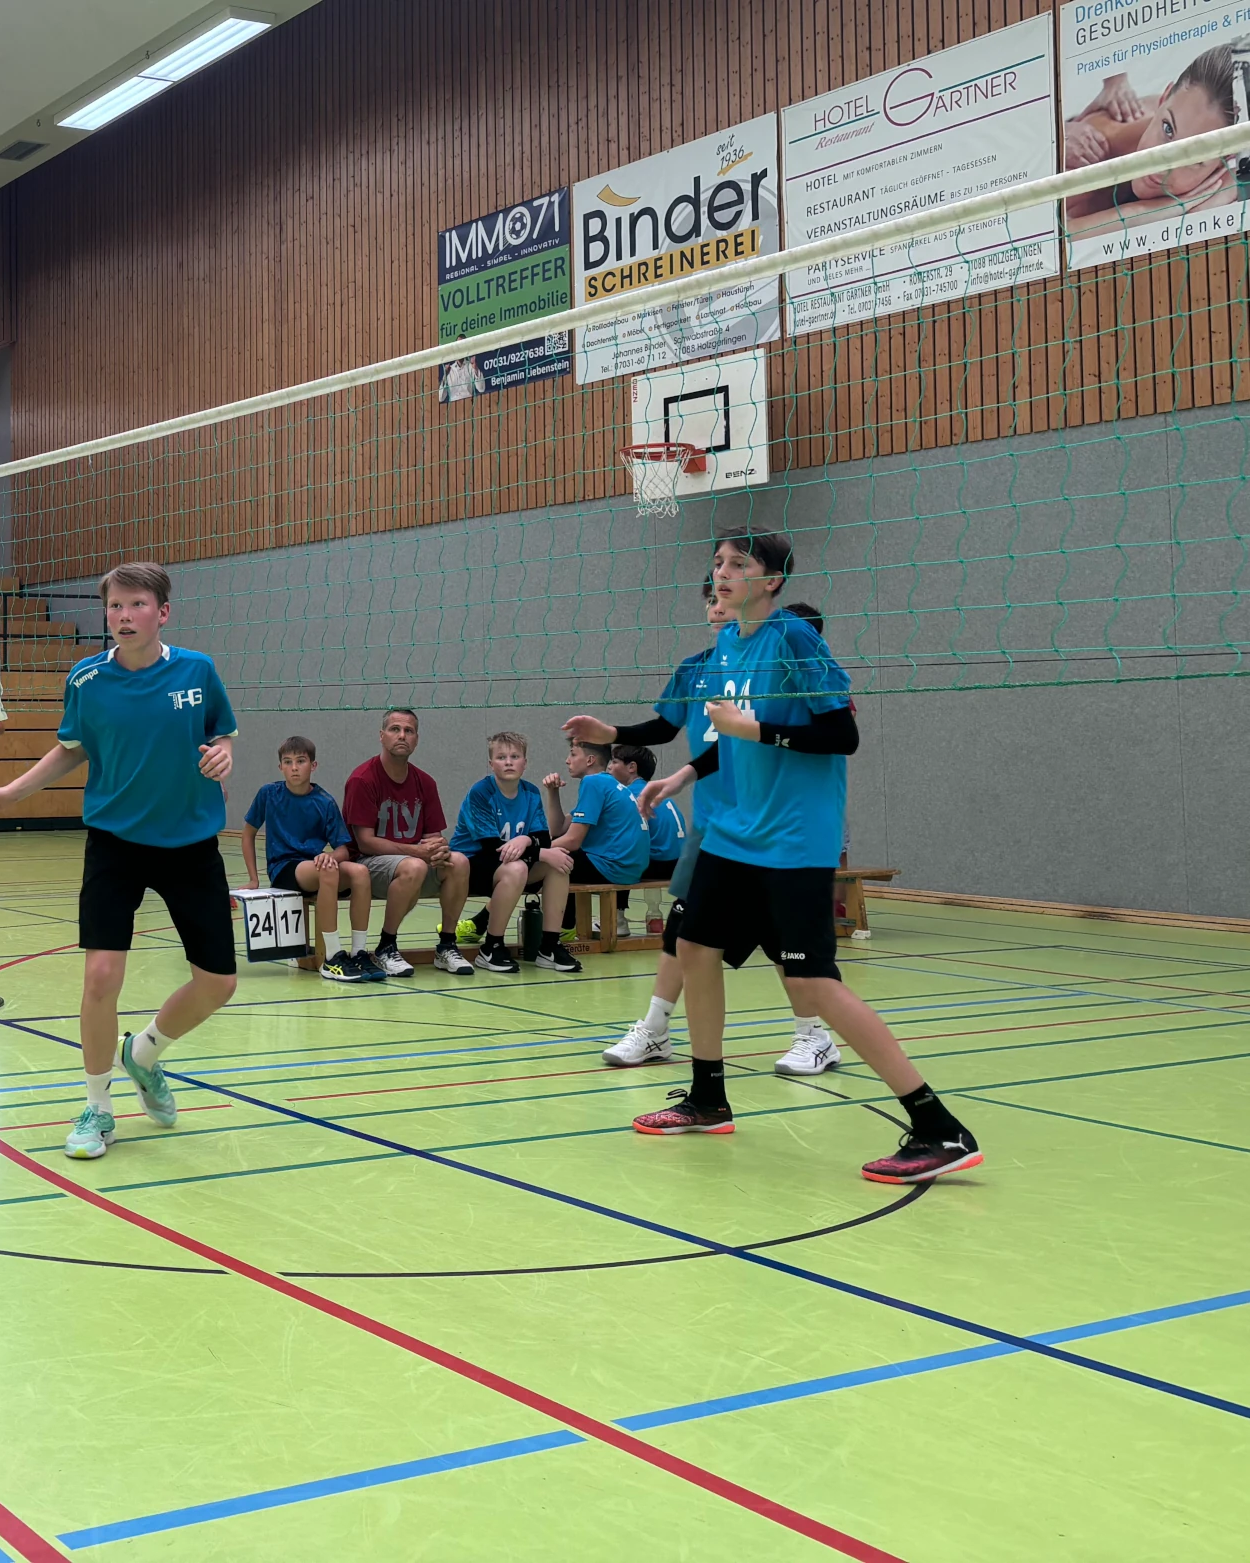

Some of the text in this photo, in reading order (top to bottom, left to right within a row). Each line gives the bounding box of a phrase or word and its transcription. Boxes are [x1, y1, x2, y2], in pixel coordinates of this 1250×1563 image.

[1077, 55, 1110, 75] Praxis
[1113, 48, 1129, 63] für
[1131, 19, 1218, 58] Physiotherapie
[1222, 14, 1232, 28] &
[814, 67, 1017, 132] HOTEL GÄRTNER
[716, 133, 735, 156] seit
[815, 121, 876, 151] Restaurant
[720, 146, 745, 169] 1936
[805, 143, 943, 192] HOTEL MIT KOMFORTABLEN ZIMMERN
[806, 187, 876, 217] RESTAURANT
[880, 181, 908, 195] TÄGLICH
[910, 170, 944, 187] GEÖFFNET
[952, 154, 997, 174] TAGESESSEN
[583, 167, 768, 271] Binder
[806, 171, 1028, 240] VERANSTALTUNGSRÄUME BIS ZU 150 PERSONEN
[445, 193, 560, 268] IMMO71
[933, 231, 947, 242] AUS
[949, 227, 966, 237] DEM
[967, 216, 1007, 233] STEINOFEN
[1103, 213, 1245, 255] www.drenke
[446, 264, 479, 280] REGIONAL
[486, 254, 512, 267] SIMPEL
[520, 238, 560, 256] INNOVATIV
[587, 229, 758, 299] SCHREINEREI
[807, 275, 821, 286] UND
[845, 265, 864, 276] MEHR
[944, 266, 953, 278] 29
[967, 256, 986, 271] 1088
[441, 257, 566, 312] VOLLTREFFER
[847, 304, 857, 315] Tel.
[903, 290, 913, 302] Fax
[914, 279, 958, 300] 0731-745700
[440, 290, 568, 339] für deine Immobilie
[612, 346, 643, 359] Johannes
[657, 351, 667, 361] 12
[491, 370, 525, 386] Benjamin
[725, 468, 756, 479] BENZ
[73, 668, 99, 689] Kempa
[377, 797, 423, 839] fly
[250, 909, 302, 938] 24 17
[787, 952, 806, 960] JAKO
